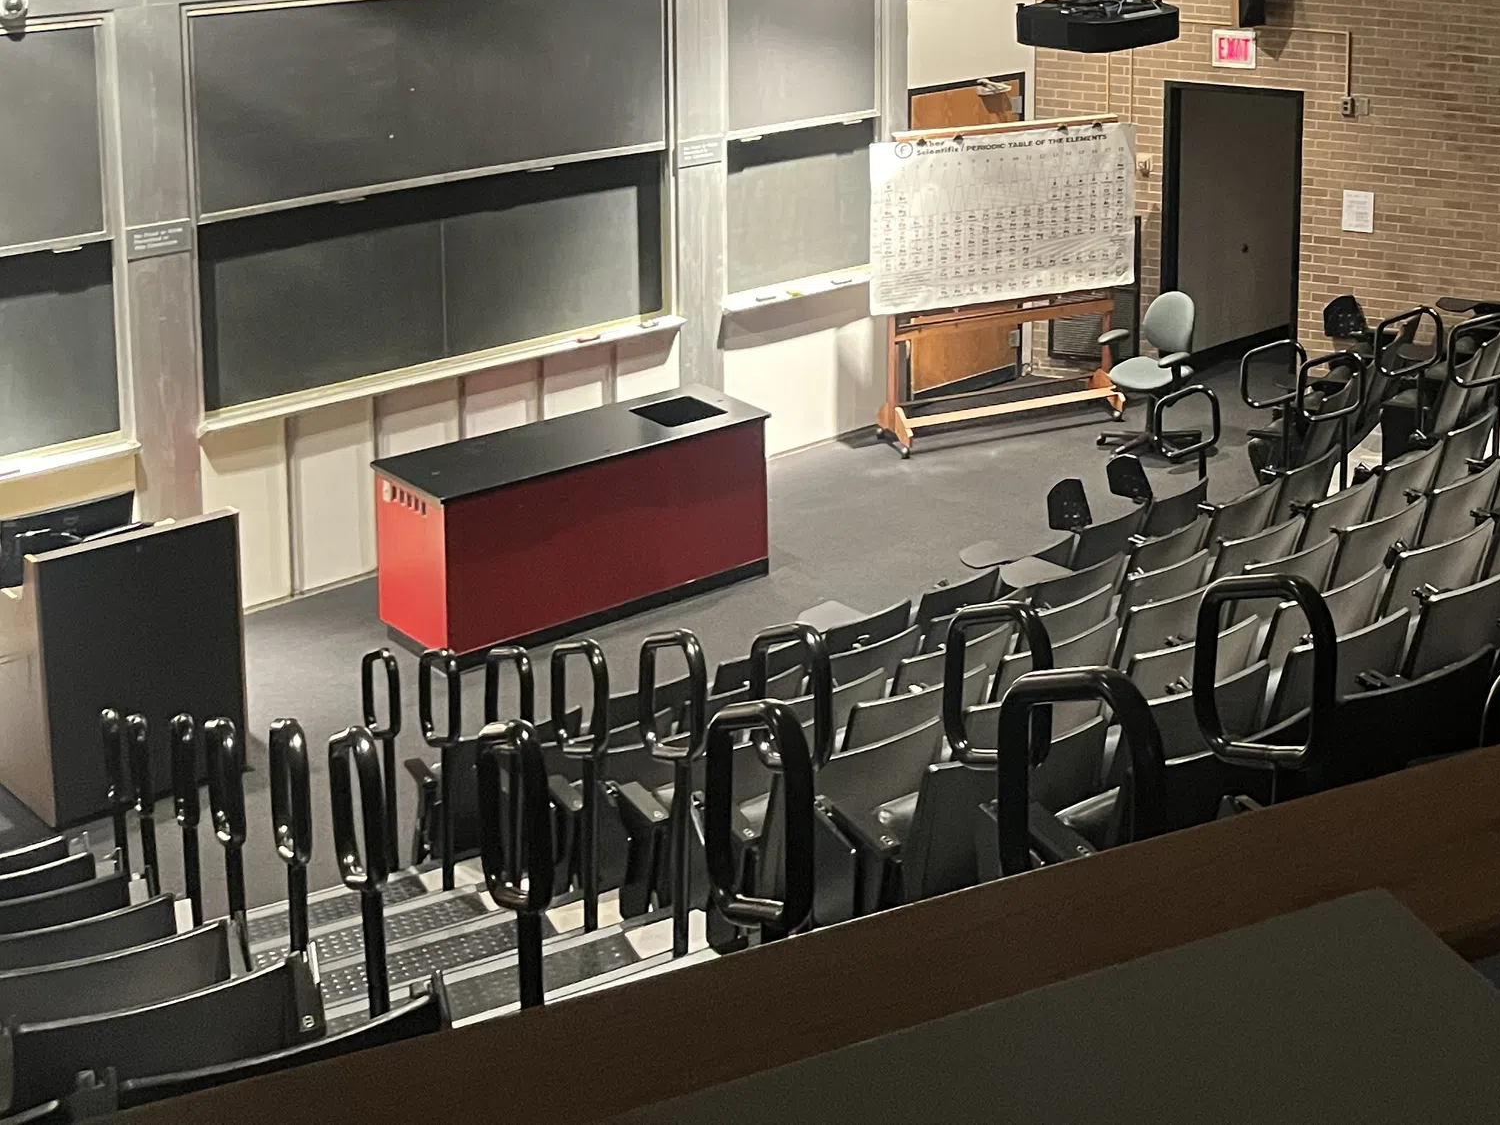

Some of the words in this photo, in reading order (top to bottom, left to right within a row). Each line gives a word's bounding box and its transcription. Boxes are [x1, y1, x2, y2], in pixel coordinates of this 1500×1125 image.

[1218, 37, 1251, 61] EXIT
[966, 143, 1004, 151] PERIODIC
[1065, 134, 1107, 142] ELEMENTS
